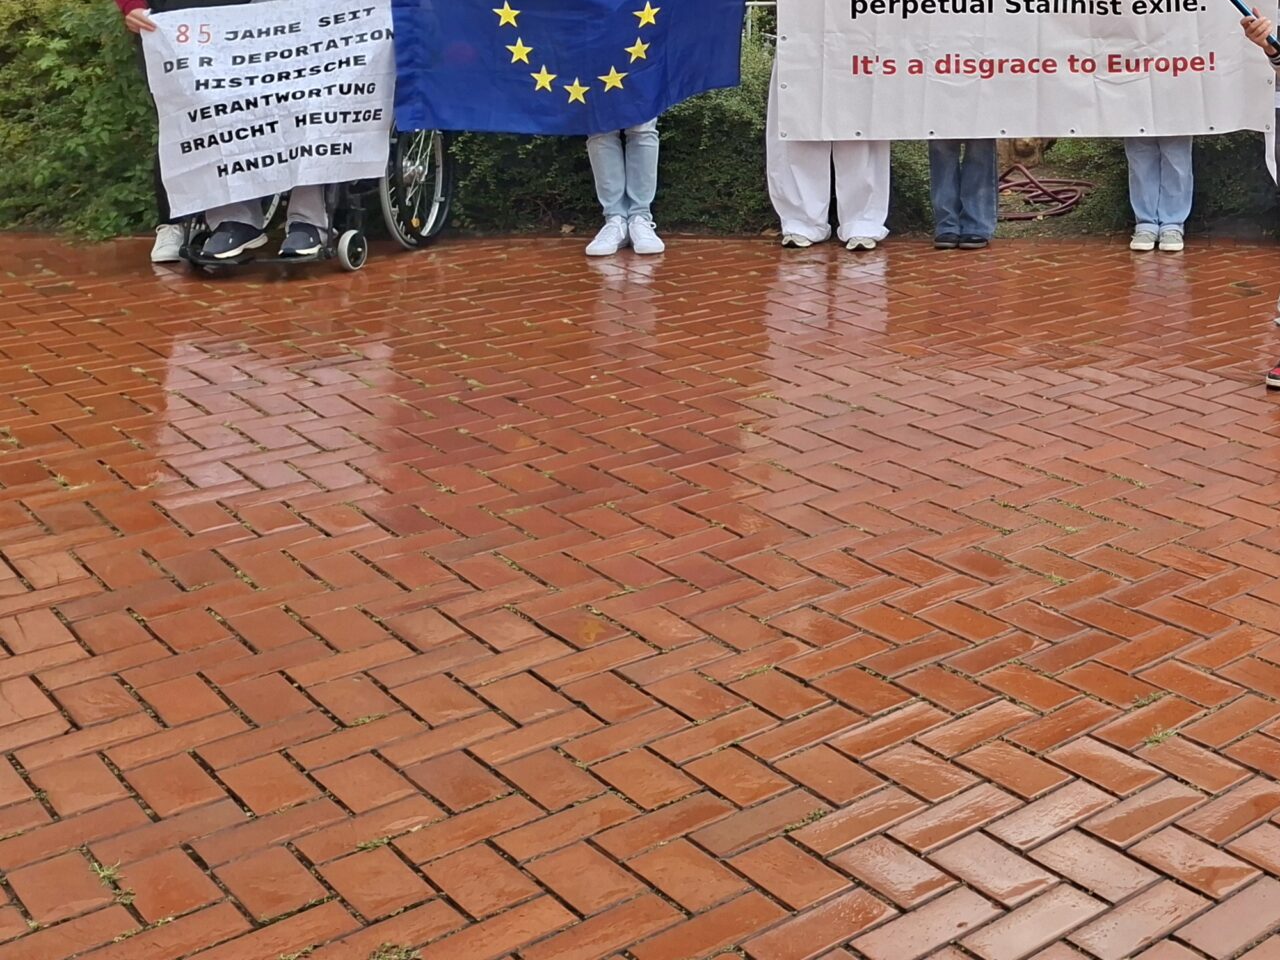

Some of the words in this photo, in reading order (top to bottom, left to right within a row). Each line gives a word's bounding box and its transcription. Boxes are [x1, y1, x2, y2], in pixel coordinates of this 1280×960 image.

[176, 24, 210, 43] 85
[224, 22, 301, 41] JAHRE
[318, 7, 375, 27] SEIT
[195, 55, 366, 91] HISTORISCHE
[853, 55, 896, 75] It's
[908, 59, 923, 74] a
[935, 53, 1057, 79] disgrace
[1068, 55, 1096, 73] to
[1108, 52, 1214, 77] Europe!
[187, 83, 376, 122] VERANTWORTUNG
[180, 121, 278, 154] BRAUCHT
[295, 109, 382, 128] HEUTIGE
[217, 142, 352, 177] HANDLUNGEN
